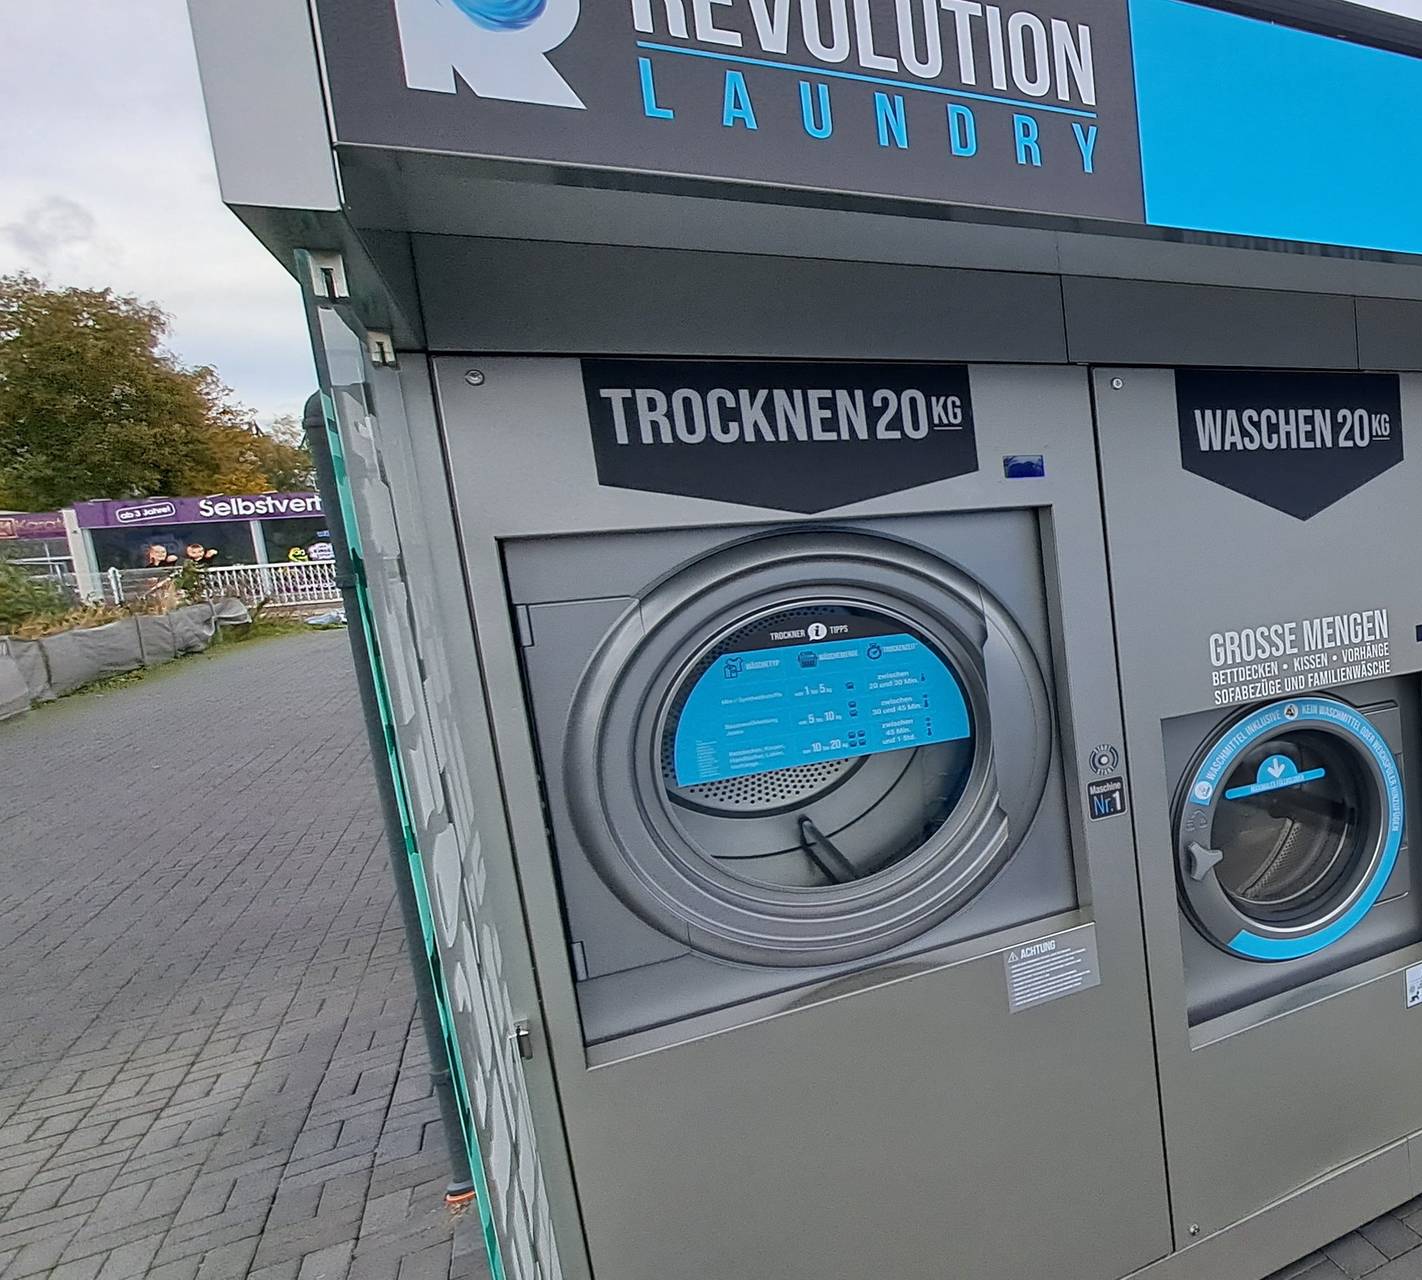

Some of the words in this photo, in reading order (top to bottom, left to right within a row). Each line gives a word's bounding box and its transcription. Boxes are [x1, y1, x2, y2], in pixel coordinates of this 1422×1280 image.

[637, 57, 1097, 174] LAUNDRY
[599, 388, 869, 445] TROCKNEN
[1194, 408, 1333, 451] WASCHEN
[770, 629, 805, 641] TROCKNER
[830, 625, 849, 634] TIPPS
[1209, 622, 1299, 667] GROSSE
[1303, 608, 1389, 651] MENGEN
[1212, 661, 1279, 686] BETTDECKEN
[1293, 652, 1328, 672] KISSEN
[1341, 642, 1390, 663] VORHÄNGE
[1214, 676, 1282, 705] SOFABEZÜGE
[1284, 676, 1305, 692] UND
[1308, 659, 1391, 687] FAMILIENWÄSCHE
[824, 711, 835, 721] 10
[830, 738, 842, 749] 20
[1206, 731, 1248, 781] WASCHMITTEL
[1245, 709, 1282, 736] INKLUSIVE
[1301, 704, 1318, 714] KEIN
[1319, 704, 1361, 731] WASCHMITTEL
[1089, 781, 1122, 796] Maschine
[1020, 939, 1056, 960] ACHTUNG
